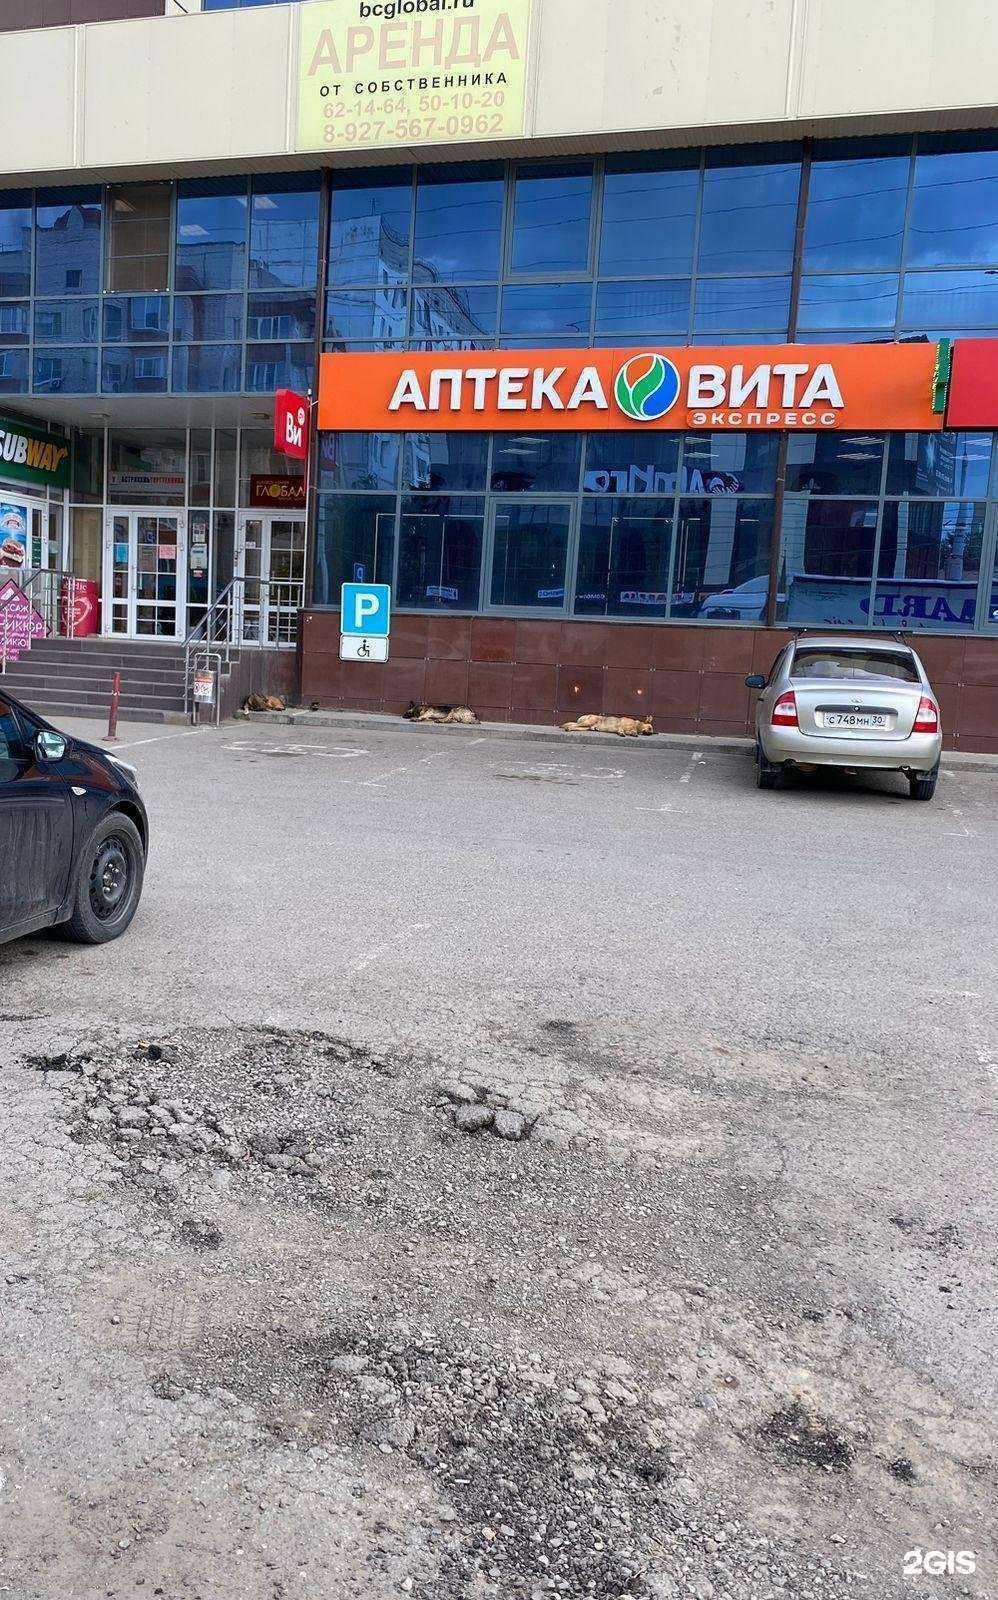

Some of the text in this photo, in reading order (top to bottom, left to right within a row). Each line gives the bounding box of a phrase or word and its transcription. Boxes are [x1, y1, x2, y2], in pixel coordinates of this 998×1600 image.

[359, 0, 474, 19] bcglobal.ru
[308, 13, 520, 76] АРЕНДА
[320, 72, 507, 97] ОТ СОБСТВЕННИКА
[419, 91, 505, 112] 50-10-20
[323, 113, 504, 143] 8-927-567-0962
[388, 363, 845, 411] АПТЕКА ВИТА
[692, 412, 836, 426] ЭКСПРЕСС
[872, 715, 883, 724] 30
